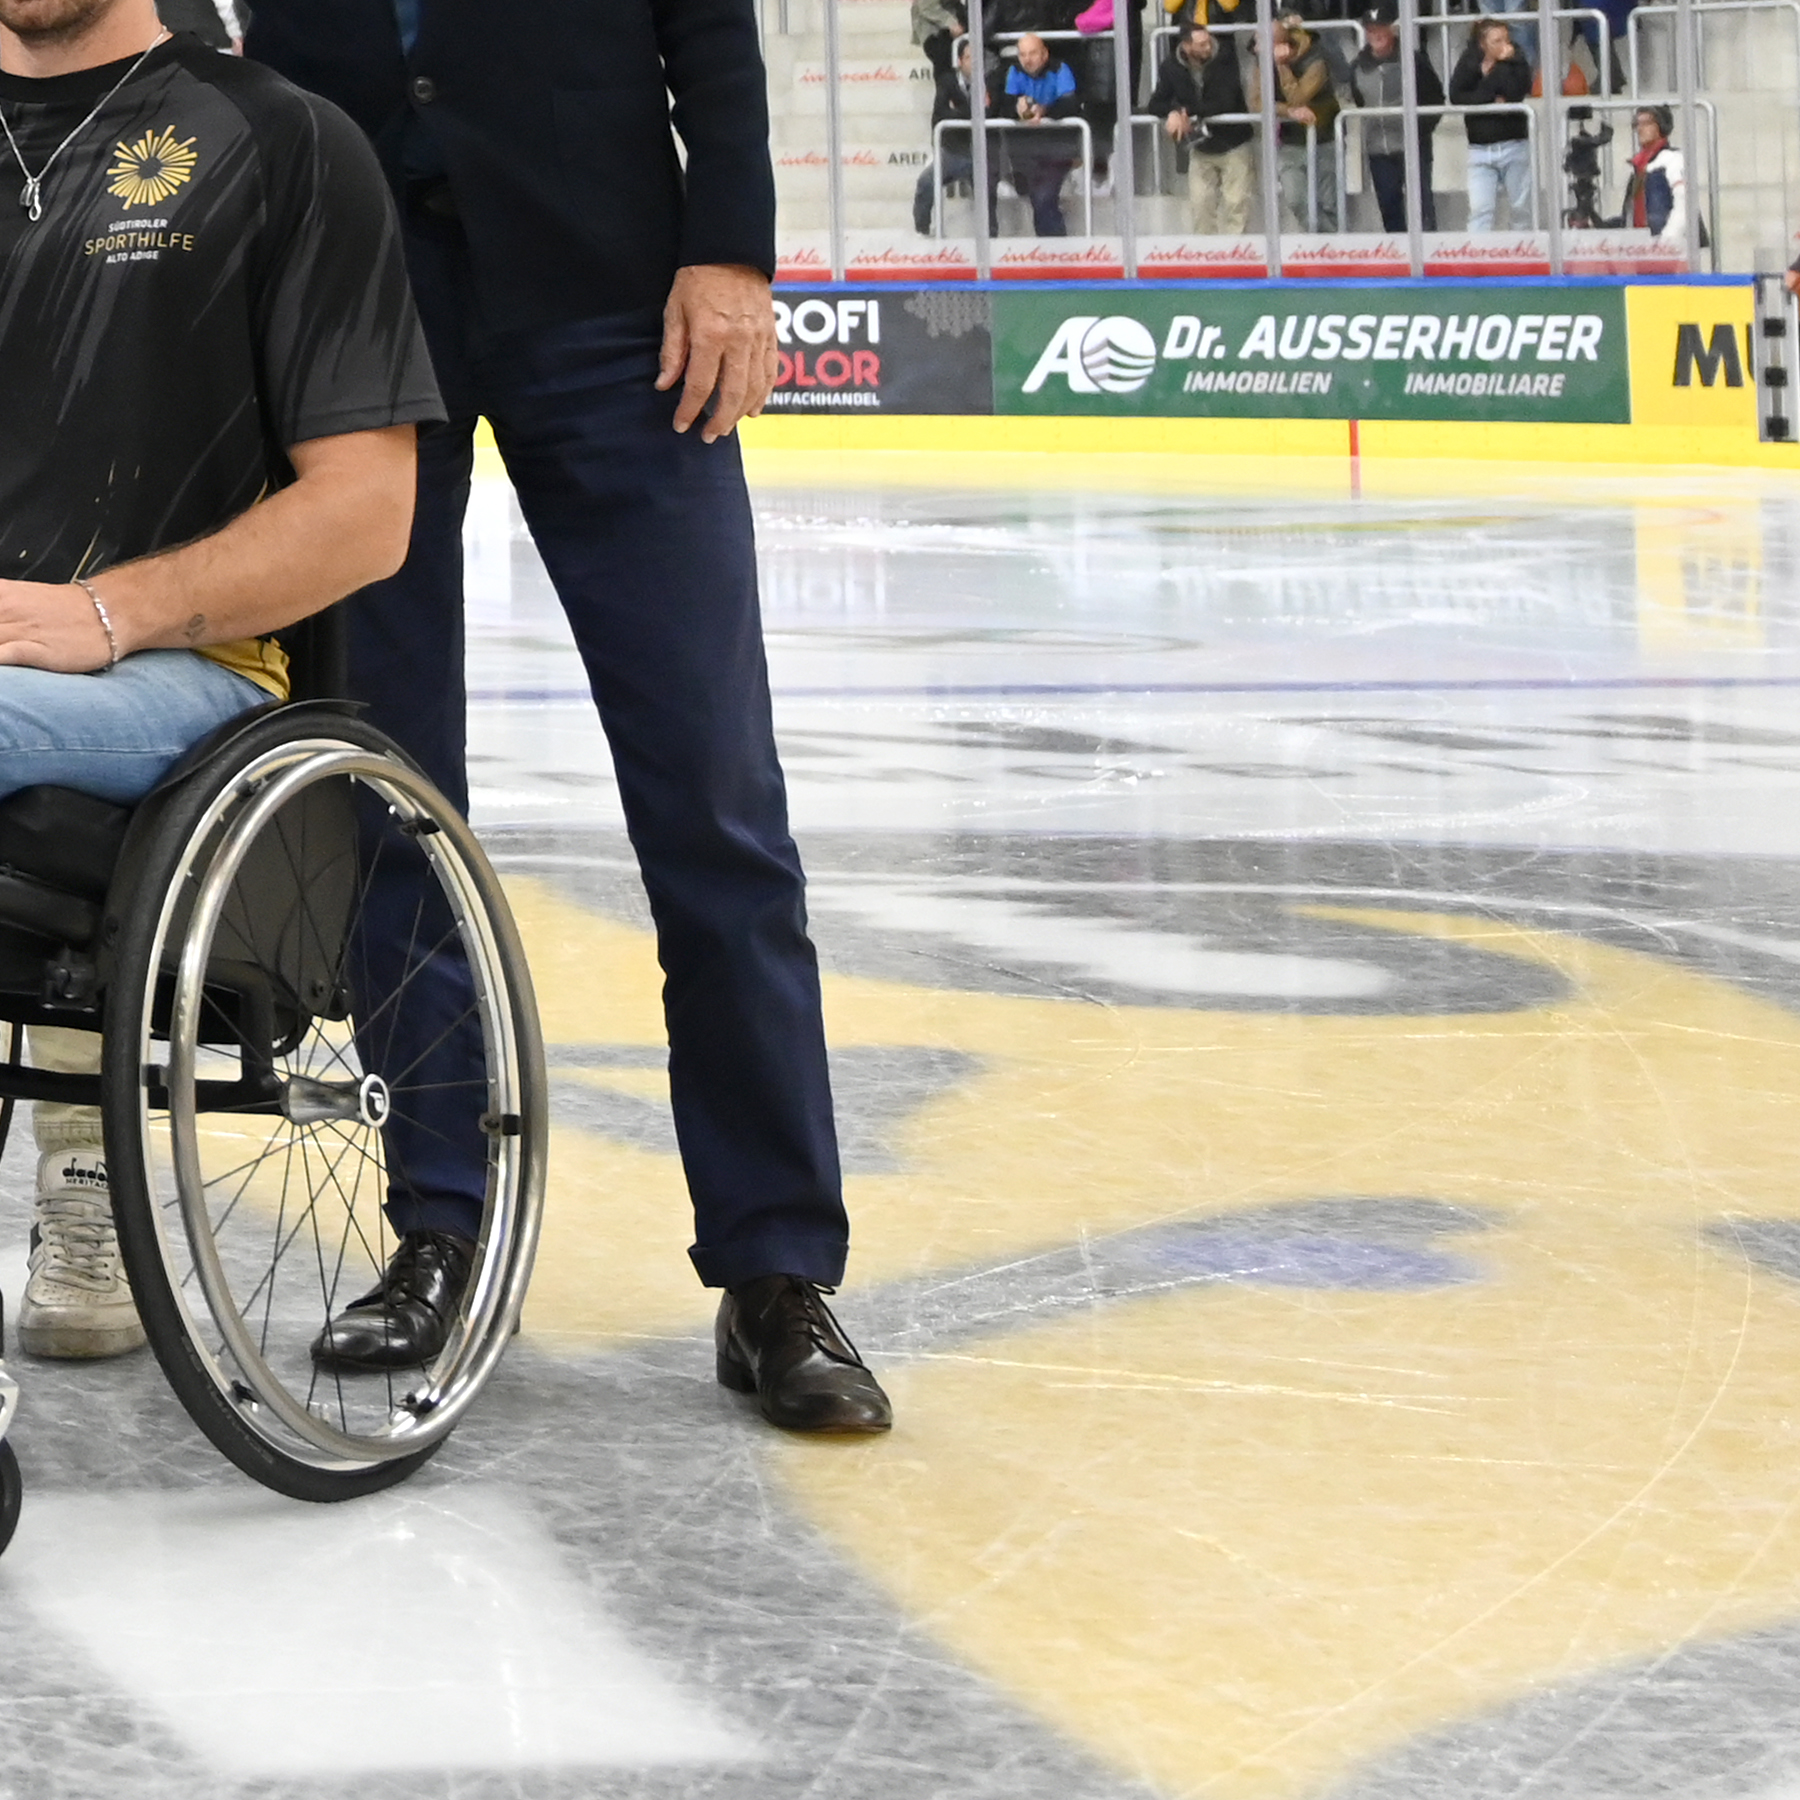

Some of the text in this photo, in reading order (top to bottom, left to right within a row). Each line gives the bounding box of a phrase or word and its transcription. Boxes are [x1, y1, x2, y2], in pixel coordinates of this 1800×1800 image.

[107, 218, 168, 233] SÜDTIROLER
[84, 233, 195, 256] SPORTHILFE
[997, 244, 1119, 264] intercable
[1143, 243, 1265, 263] intercable
[1288, 241, 1407, 261] intercable
[1429, 240, 1548, 260] intercable
[105, 250, 159, 265] ALTO ADIGE
[849, 246, 970, 265] intercable
[772, 299, 880, 344] ROFI
[1162, 314, 1604, 361] Dr. AUSSERHOFER
[775, 349, 881, 387] OLOR
[1183, 370, 1566, 397] IMMOBILIEN IMMOBILIARE
[65, 1177, 108, 1190] HERITAG
